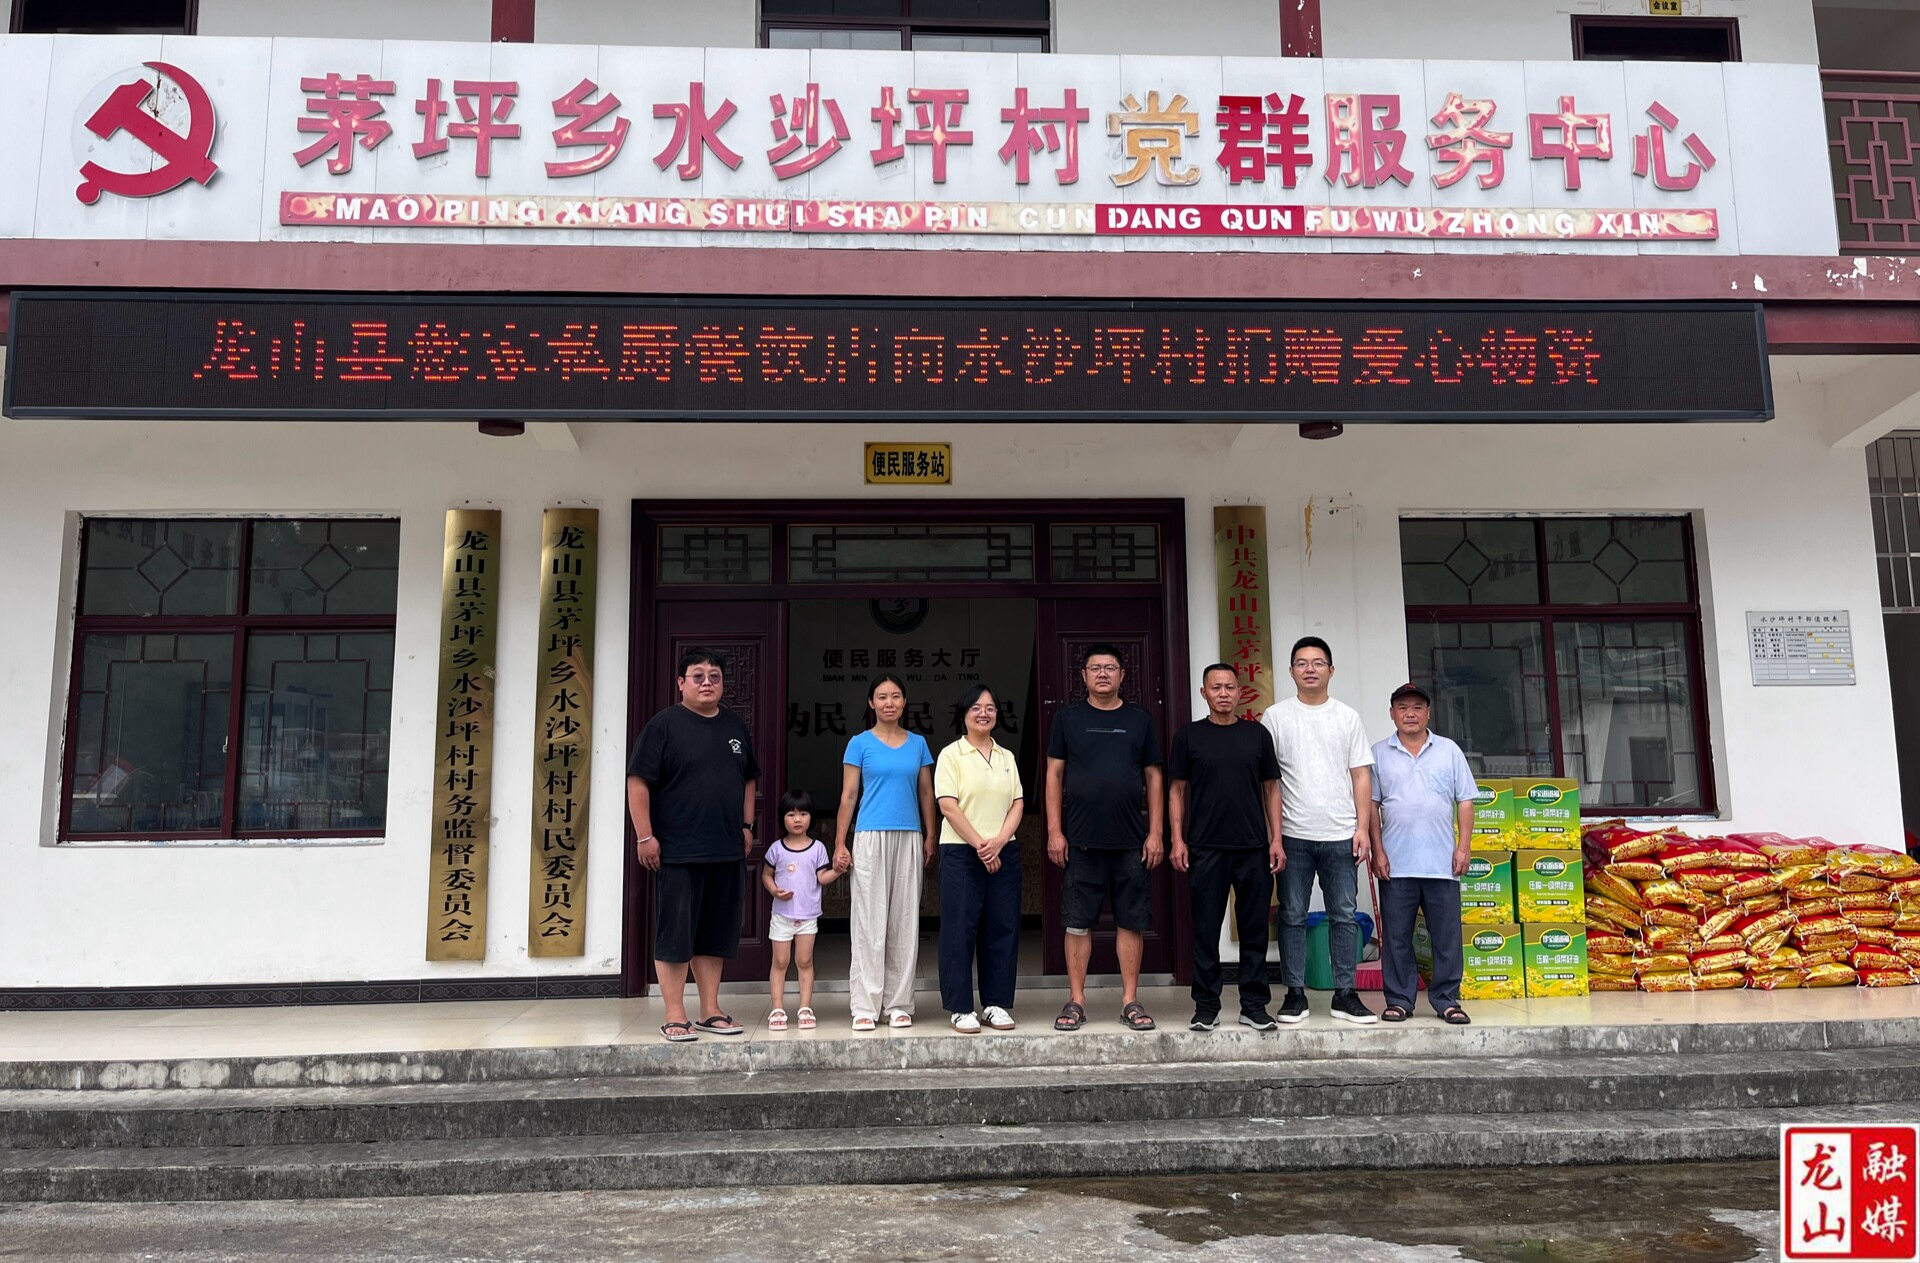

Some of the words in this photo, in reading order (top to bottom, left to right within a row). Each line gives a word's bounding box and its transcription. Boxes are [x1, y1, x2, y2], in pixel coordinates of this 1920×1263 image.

[292, 72, 1717, 191] 茅坪乡水沙坪村党群服务中心
[335, 197, 420, 222] MAO
[443, 199, 541, 224] PING
[563, 200, 688, 226] XIANG
[710, 202, 804, 228] SHUI
[827, 203, 902, 229] SHA
[925, 203, 989, 229] PIN
[1019, 206, 1095, 230] CUN
[1107, 206, 1202, 231] DANG
[1220, 208, 1293, 232] QUN
[1307, 208, 1350, 231] FU
[1372, 209, 1425, 233] WU
[1447, 211, 1576, 235] ZHONG
[1598, 212, 1660, 235] XIN
[872, 450, 945, 477] 便民服务站
[822, 648, 980, 668] 便民服务大厅
[822, 673, 844, 682] BIAN
[851, 673, 868, 682] MIN
[906, 673, 922, 682] WU
[934, 673, 947, 682] DA
[957, 673, 980, 682] TING
[439, 529, 490, 942] 龙山县茅坪乡水沙坪村村务监督委员会
[540, 526, 586, 938] 龙山县茅坪乡水沙坪村村民委员会
